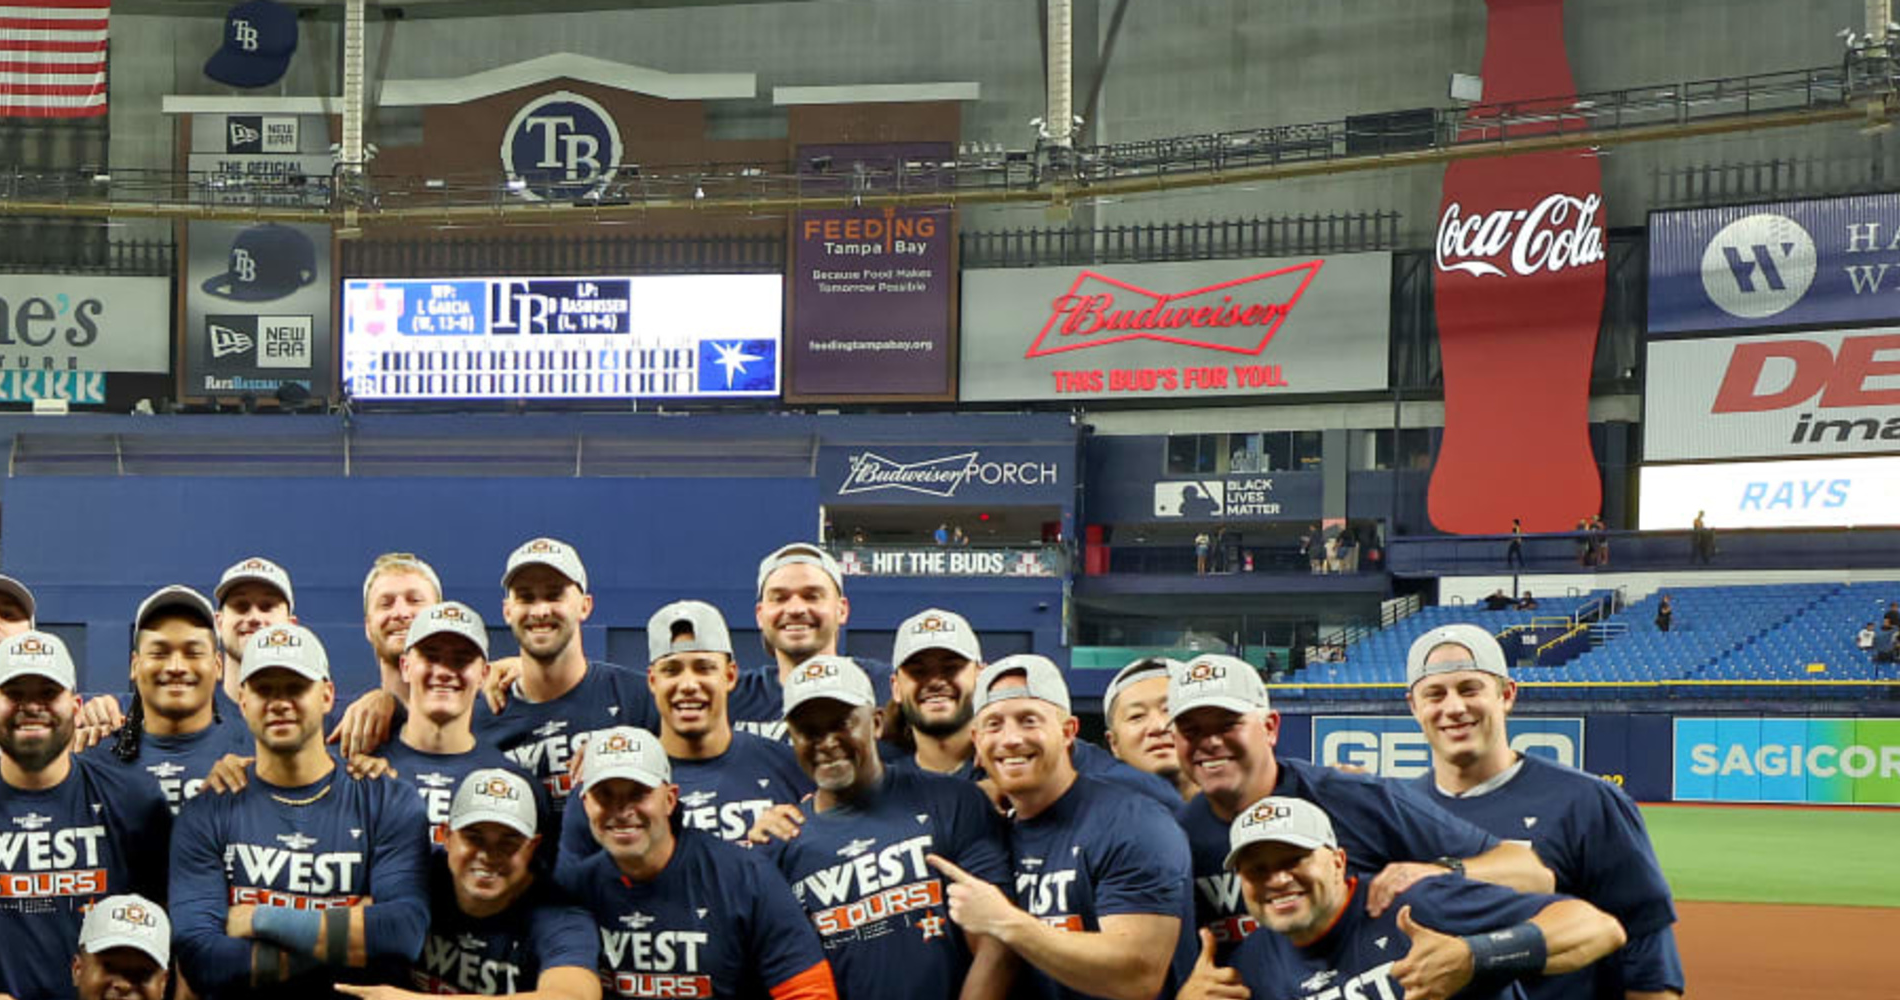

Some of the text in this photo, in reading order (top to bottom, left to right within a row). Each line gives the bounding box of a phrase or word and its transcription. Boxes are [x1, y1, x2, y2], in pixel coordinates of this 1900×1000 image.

[526, 116, 602, 185] TB
[804, 209, 936, 244] FEEDING
[1435, 193, 1605, 277] Coca-Cola
[823, 240, 927, 256] Tampa Bay
[1052, 291, 1290, 336] Budweiser
[265, 327, 306, 341] NEW
[808, 340, 933, 352] feedingtampabay.org
[265, 341, 305, 358] ERA
[1052, 364, 1289, 393] THIS BUD'S FOR YOU.
[855, 454, 1057, 485] Budweiser PORCH
[1226, 479, 1273, 491] BLACK
[1226, 492, 1265, 504] LIVES
[1738, 478, 1851, 511] RAYS
[1226, 503, 1280, 516] MATTER
[872, 552, 1004, 574] HIT THE BUDS
[234, 843, 362, 894] WEST
[805, 835, 932, 907] WEST
[11, 870, 96, 896] OURS
[846, 884, 931, 929] OURS
[616, 974, 699, 998] OURS
